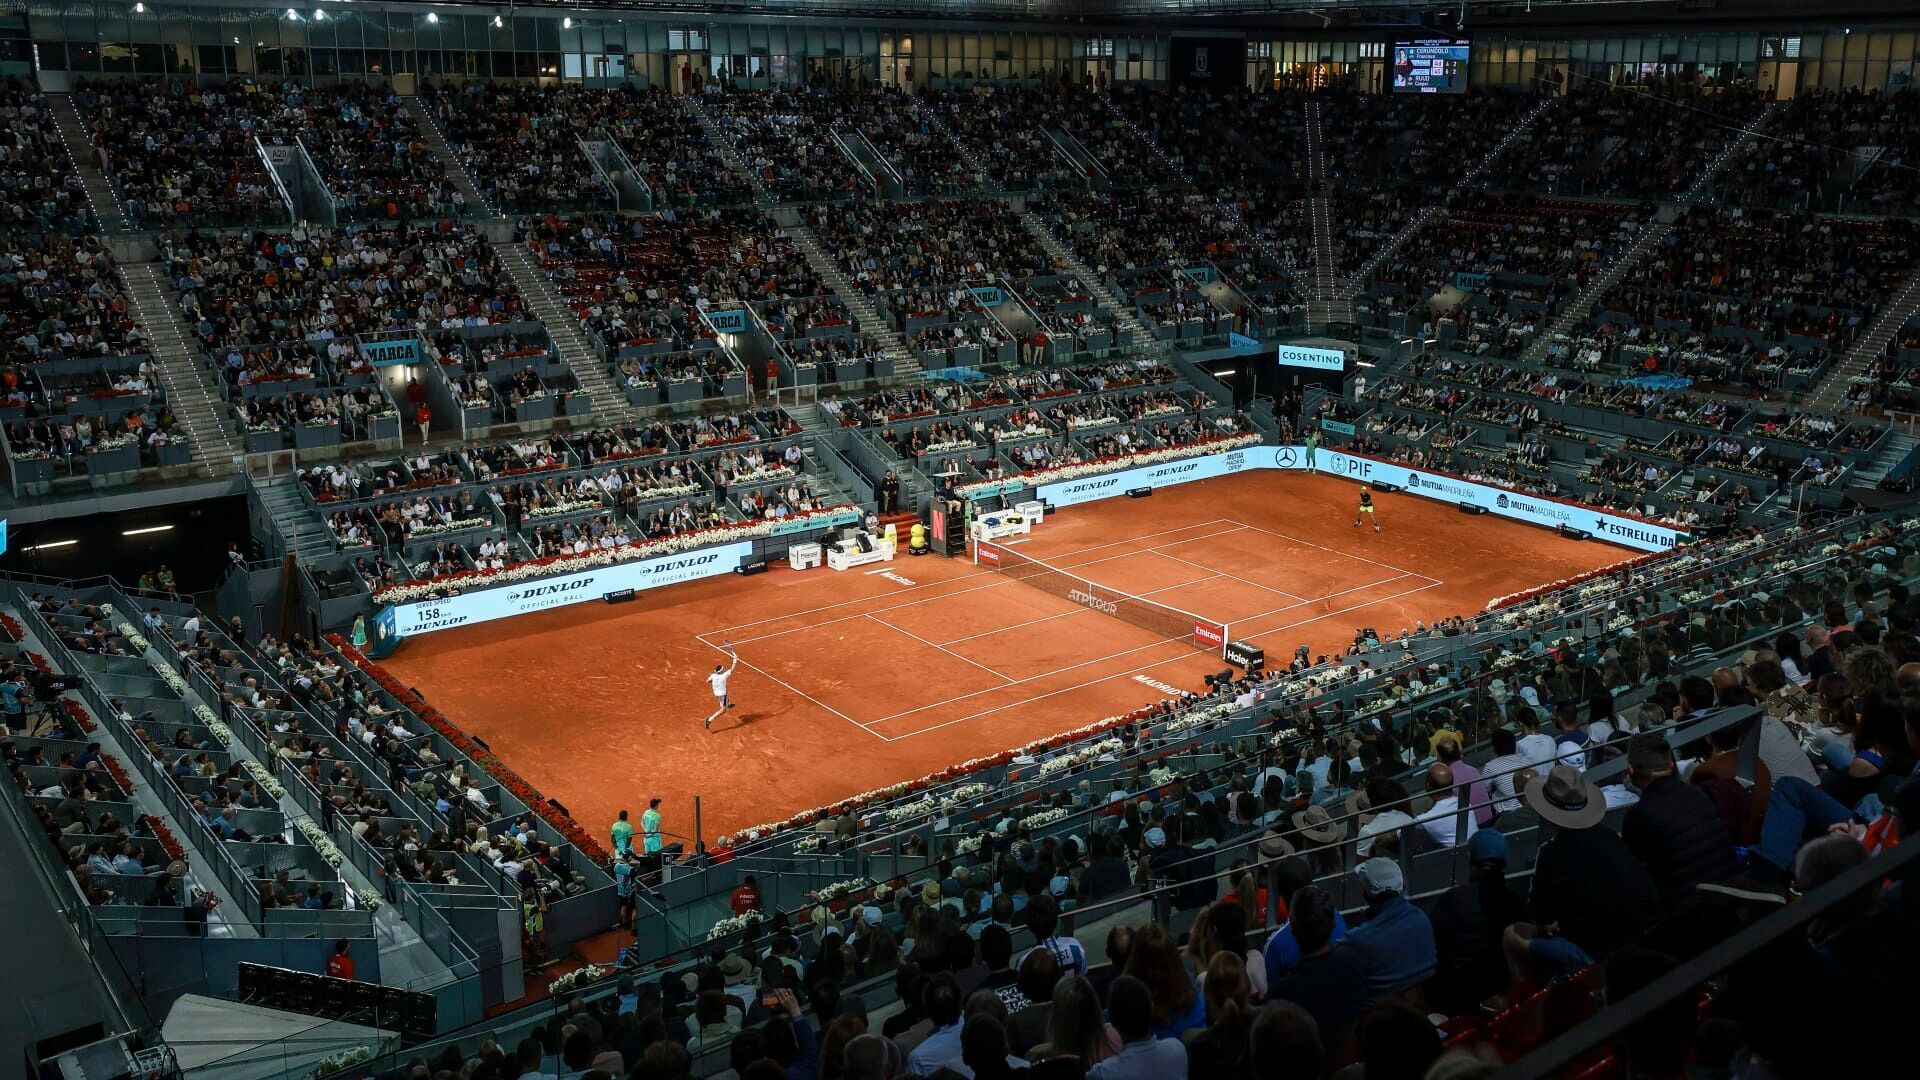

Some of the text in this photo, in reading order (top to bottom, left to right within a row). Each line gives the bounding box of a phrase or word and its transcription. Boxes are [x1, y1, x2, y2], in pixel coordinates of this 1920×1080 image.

[273, 150, 287, 158] A20
[366, 345, 414, 362] MARCA
[1282, 352, 1341, 364] COSENTINO
[1156, 463, 1198, 477] DUNLOP
[1348, 460, 1373, 477] PIF
[1073, 478, 1118, 493] DUNLOP
[1421, 480, 1475, 498] MUTUAMADRILEÑA
[1510, 501, 1571, 522] MUTUAMADRILEÑA
[932, 509, 944, 541] N
[1610, 524, 1675, 548] ESTRELLA DA
[652, 554, 718, 574] DUNLOP
[652, 574, 687, 584] OFFICIAL
[522, 578, 594, 599] DUNLOP
[416, 598, 452, 610] SERVE SPEED
[520, 594, 584, 610] OFFICIAL BALL
[1090, 596, 1118, 616] TOUR
[418, 608, 440, 622] 158
[412, 616, 468, 632] DUNLOP
[1196, 626, 1222, 642] Emirates
[1227, 650, 1249, 665] Haier
[1132, 674, 1182, 695] MADRID
